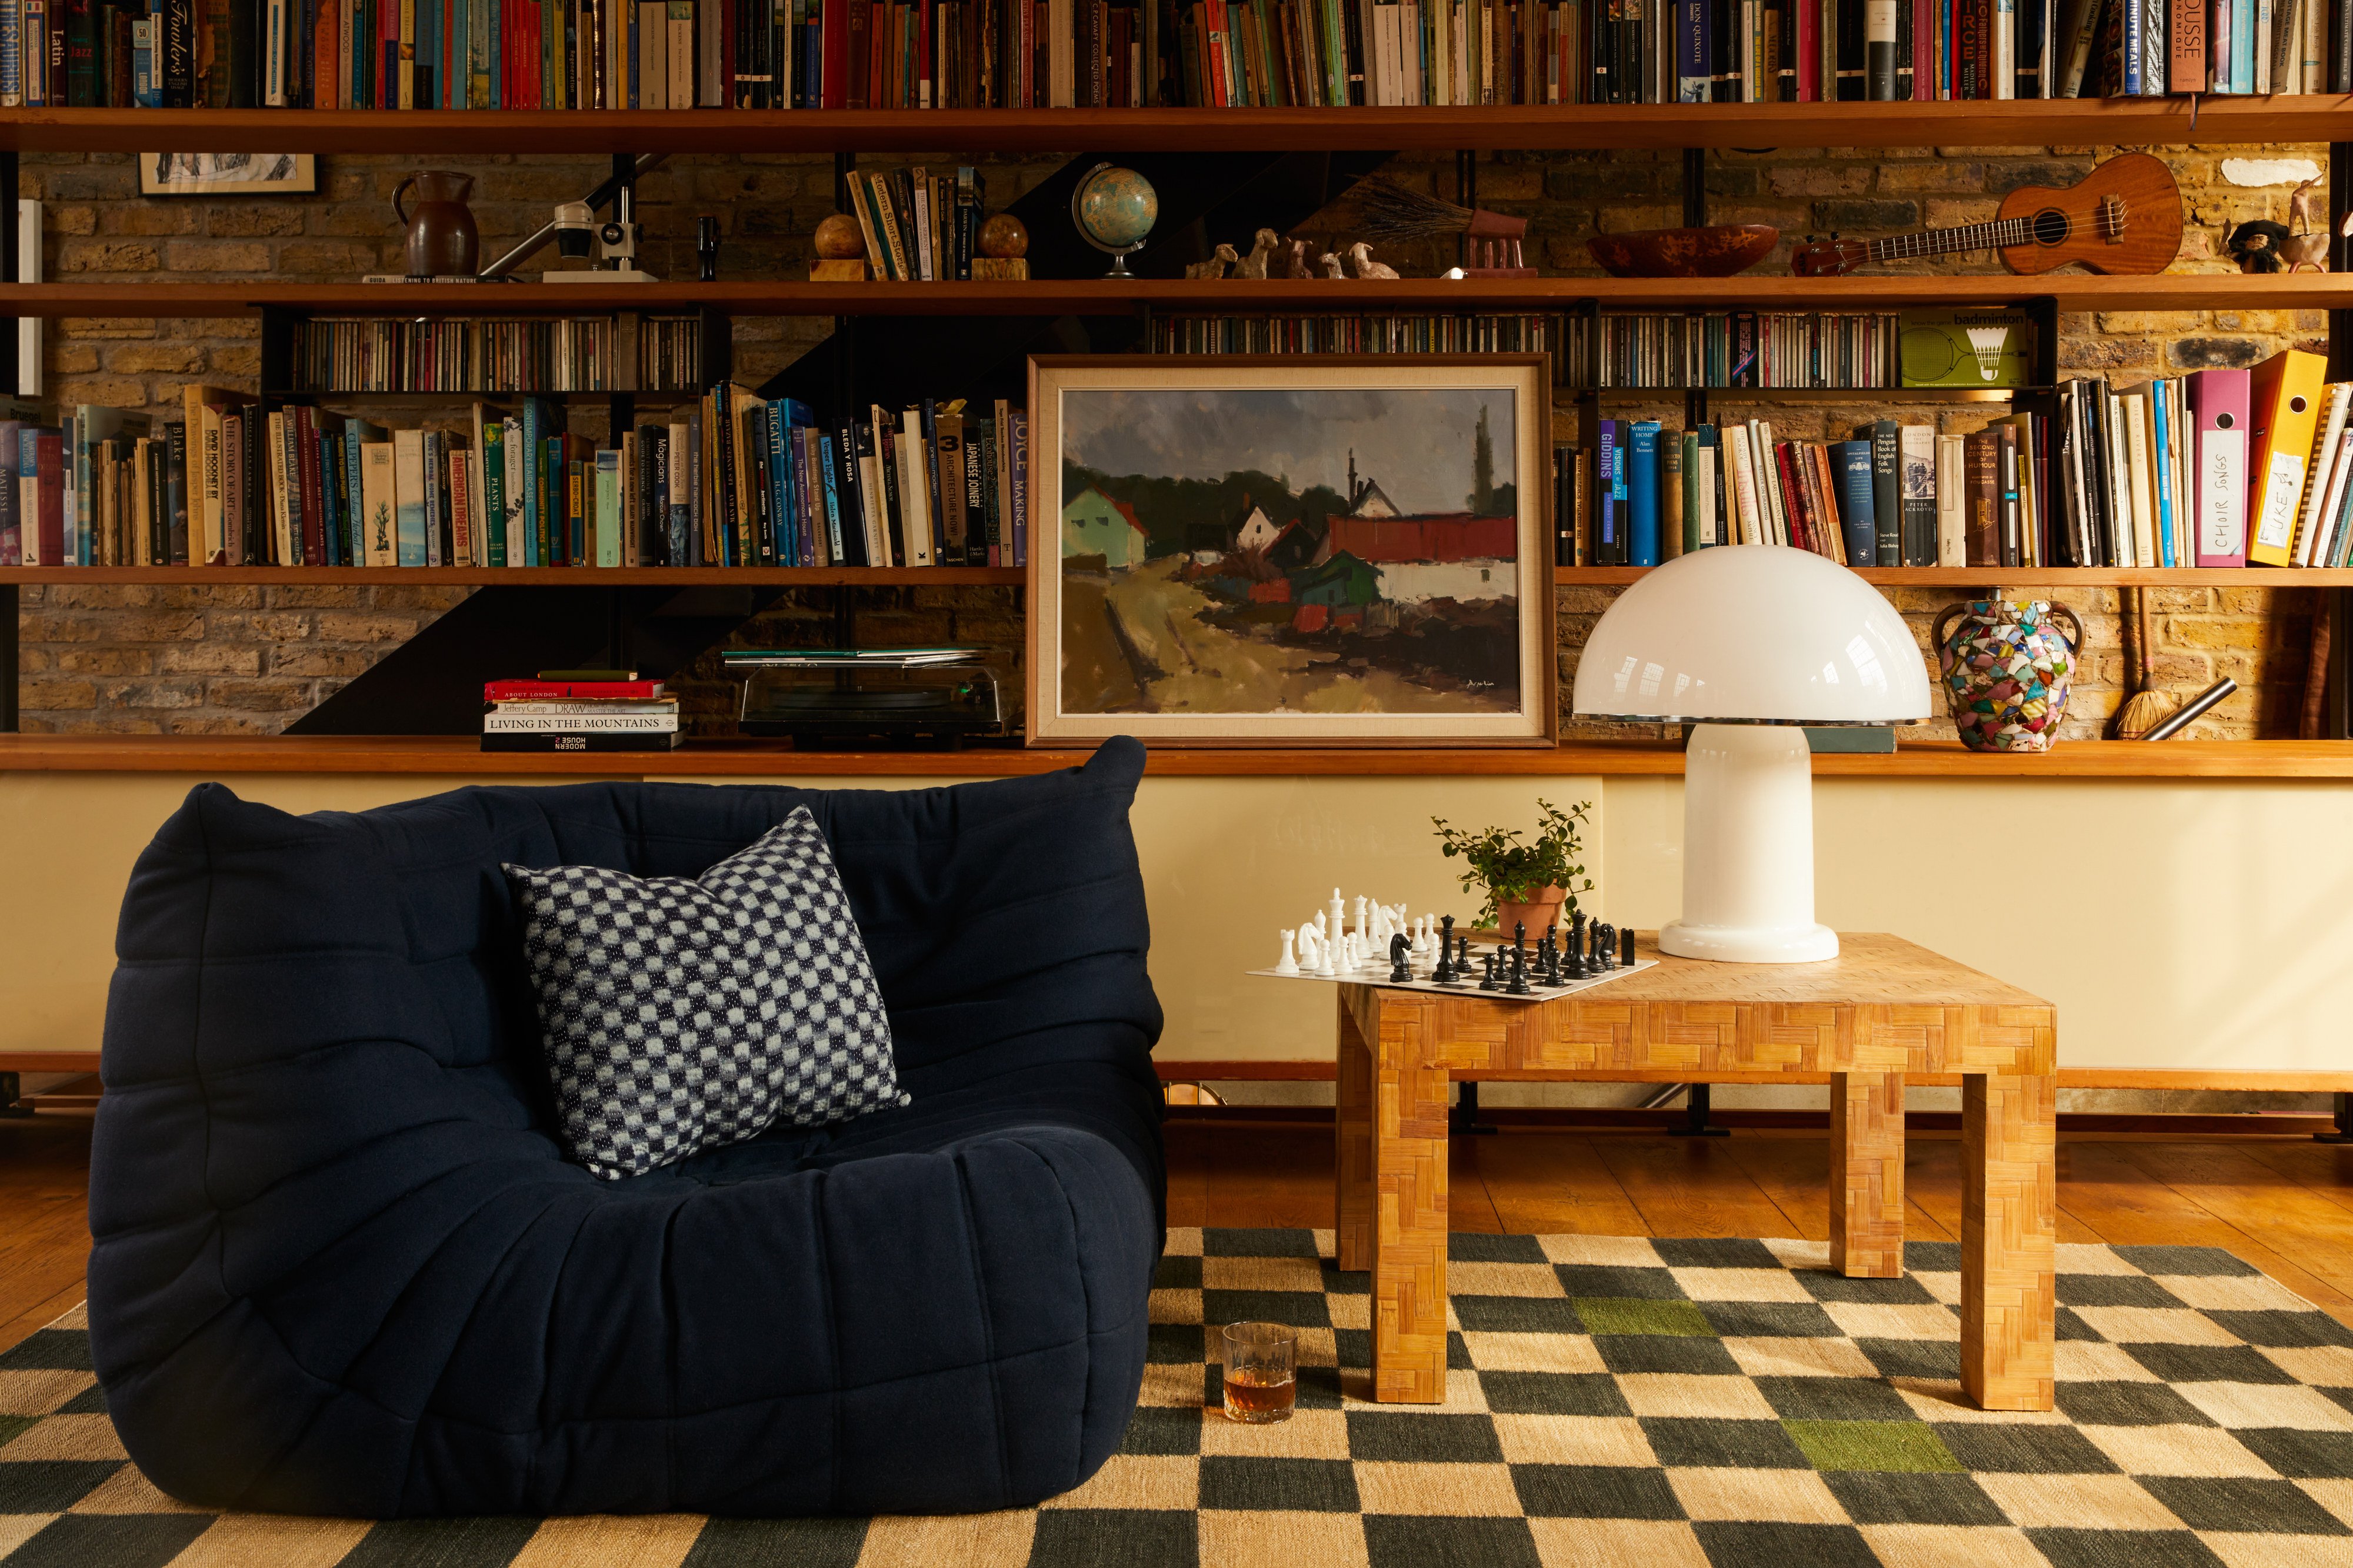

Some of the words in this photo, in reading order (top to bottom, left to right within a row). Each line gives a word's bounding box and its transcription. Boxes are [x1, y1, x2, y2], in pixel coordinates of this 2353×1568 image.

[139, 28, 146, 37] 50
[1978, 19, 1988, 44] Fathers
[2084, 4, 2097, 31] Cooking
[0, 0, 19, 92] THESAURUS
[52, 30, 64, 66] Latin
[71, 46, 92, 57] Jazz
[171, 0, 187, 75] Fowler's
[1693, 25, 1701, 64] QUIXOTE
[1978, 51, 1988, 77] Children
[2129, 39, 2138, 74] MEALS
[139, 72, 148, 94] LONDON
[874, 174, 888, 211] Modern
[885, 212, 897, 239] Short
[892, 241, 905, 275] Stories
[1954, 313, 2024, 325] badminton
[10, 408, 41, 424] Bruegel
[189, 400, 198, 416] The
[274, 418, 282, 430] THE
[173, 427, 182, 461] Blake
[188, 418, 199, 458] Drawings
[226, 420, 235, 440] THE
[286, 419, 294, 452] WILLIAM
[525, 403, 533, 461] CONTEMPORARY
[768, 407, 781, 455] BUGATTI
[1015, 418, 1028, 471] JOYCE
[192, 461, 200, 469] of
[226, 442, 235, 475] STORY
[275, 432, 284, 473] ILLUSTRATED
[347, 433, 358, 488] CULPEPER'S
[508, 444, 518, 471] forager
[655, 439, 666, 483] Magicians
[966, 443, 978, 478] JAPANESE
[986, 437, 995, 475] Ecohouse
[1601, 433, 1612, 478] GIDDINS
[190, 470, 200, 496] Jasper
[226, 476, 235, 489] OF
[452, 456, 465, 505] AMERICAN
[824, 465, 833, 483] Flights
[946, 454, 955, 512] ARCHITECTURE
[2215, 453, 2229, 491] SONGS
[0, 469, 8, 513] MATISSE
[211, 491, 218, 499] BY
[227, 491, 236, 509] ART
[351, 490, 359, 516] Colour
[969, 479, 979, 508] JOINERY
[1015, 481, 1024, 526] MAKING
[1737, 469, 1757, 516] Insults
[189, 498, 201, 521] Johns
[949, 511, 958, 536] NOW!
[1761, 495, 1769, 521] DRAWING
[2215, 501, 2229, 547] CHOIR
[2270, 492, 2288, 530] UKE
[226, 513, 235, 547] Gombrich
[352, 517, 361, 546] Herbal
[455, 508, 468, 548] DREAMS
[490, 720, 534, 729] LIVING
[538, 720, 552, 728] IN
[555, 720, 581, 728] THE
[584, 719, 659, 728] MOUNTAINS
[503, 704, 525, 714] Jeffery
[526, 705, 546, 714] Camp
[555, 704, 588, 713] DRAW
